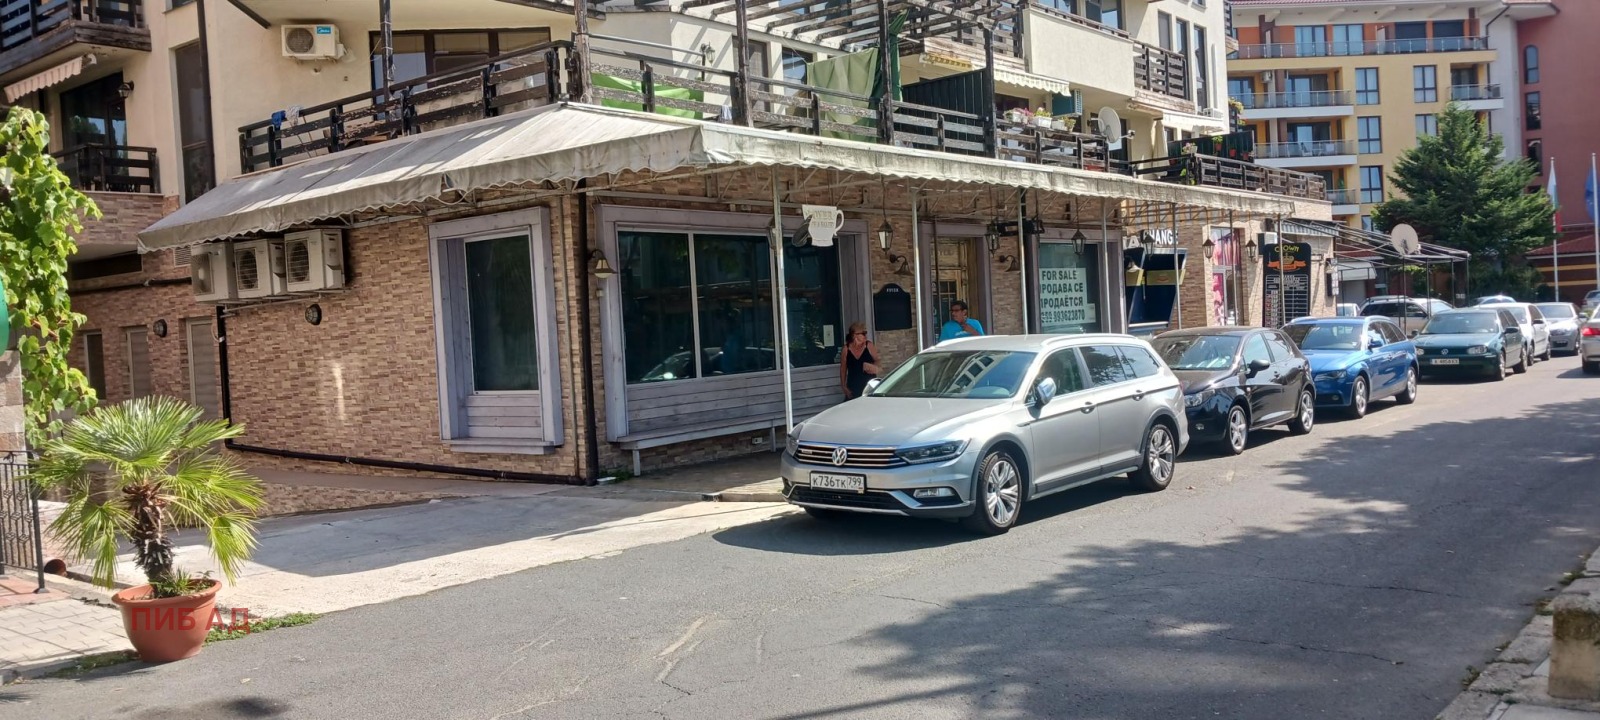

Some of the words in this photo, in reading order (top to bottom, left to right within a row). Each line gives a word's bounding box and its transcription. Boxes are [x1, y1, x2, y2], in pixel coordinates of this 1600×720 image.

[1274, 244, 1299, 253] COWN
[1042, 271, 1057, 281] FOR
[1058, 270, 1077, 280] SALE
[1040, 283, 1072, 295] РОДАВА
[1074, 283, 1084, 292] СЕ
[847, 476, 862, 486] 799
